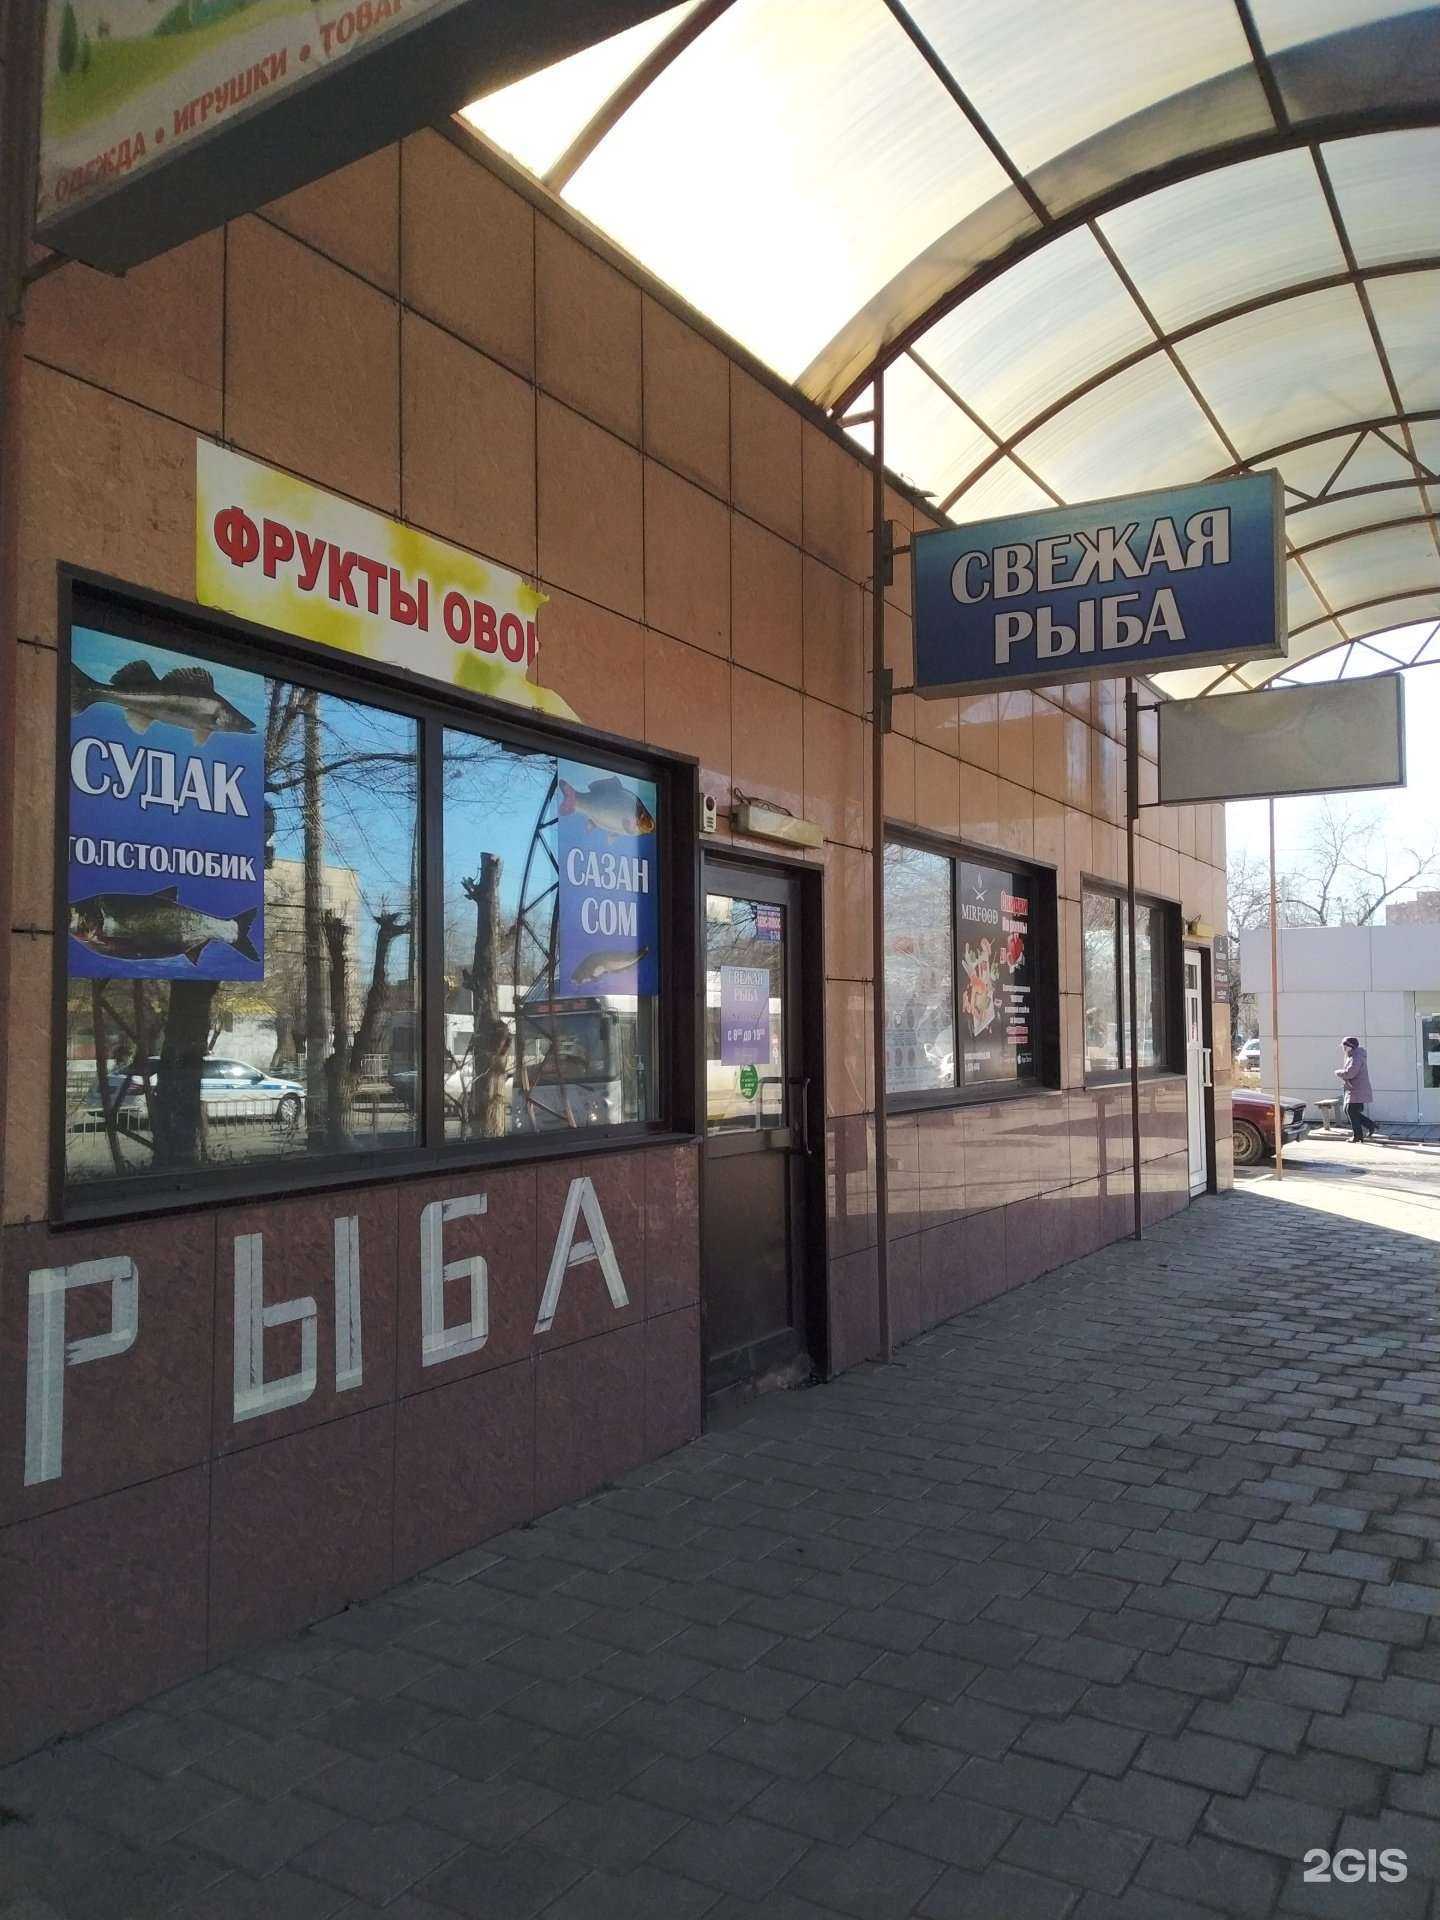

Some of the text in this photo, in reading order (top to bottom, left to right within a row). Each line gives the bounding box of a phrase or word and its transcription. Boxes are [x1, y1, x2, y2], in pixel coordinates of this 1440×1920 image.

[55, 131, 146, 201] ОДЕЖДА
[173, 48, 288, 137] ИГРУШКИ
[213, 506, 429, 632] ФРУКТЫ
[951, 506, 1232, 606] СВЕЖАЯ
[994, 587, 1187, 665] РЫБА
[70, 736, 249, 818] СУДАК
[566, 847, 649, 894] САЗАН
[581, 897, 638, 937] СОМ
[961, 903, 999, 925] MIRFOOD
[24, 1176, 630, 1487] РЫБА
